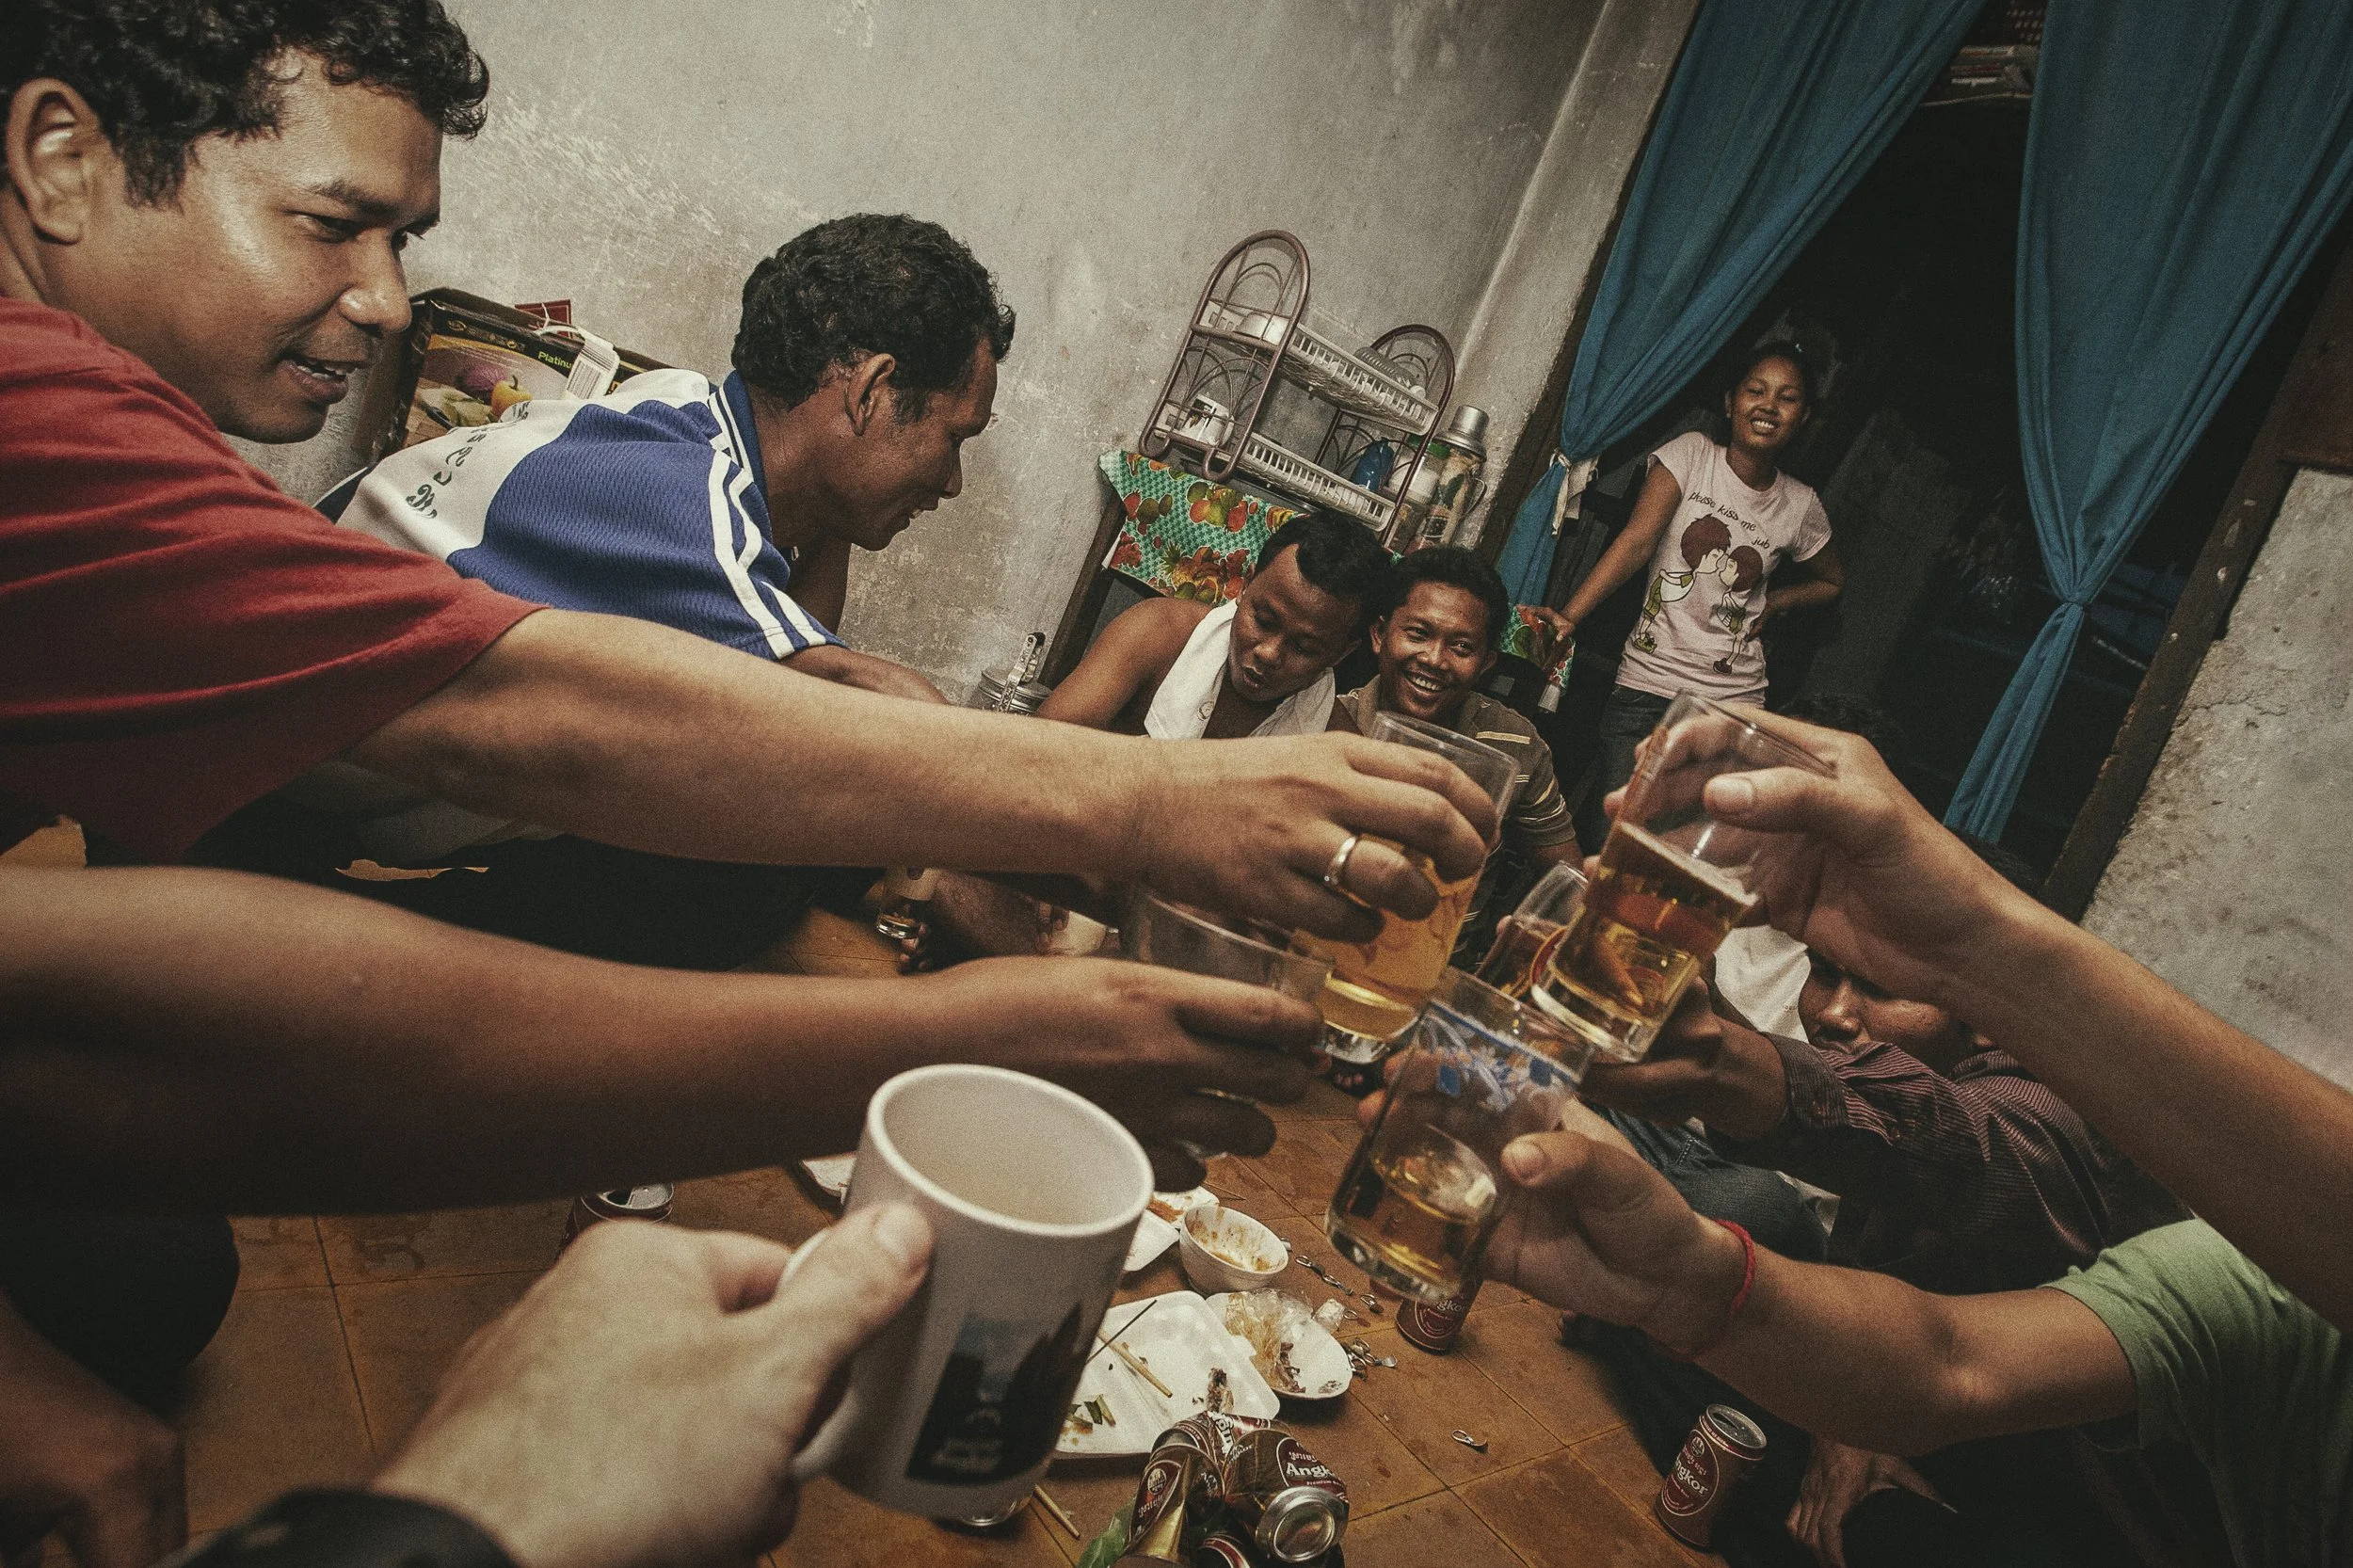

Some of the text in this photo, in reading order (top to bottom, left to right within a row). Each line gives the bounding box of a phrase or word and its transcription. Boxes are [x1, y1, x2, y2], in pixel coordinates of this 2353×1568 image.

[1688, 491, 1757, 532] please kiss me
[1752, 536, 1770, 550] jub
